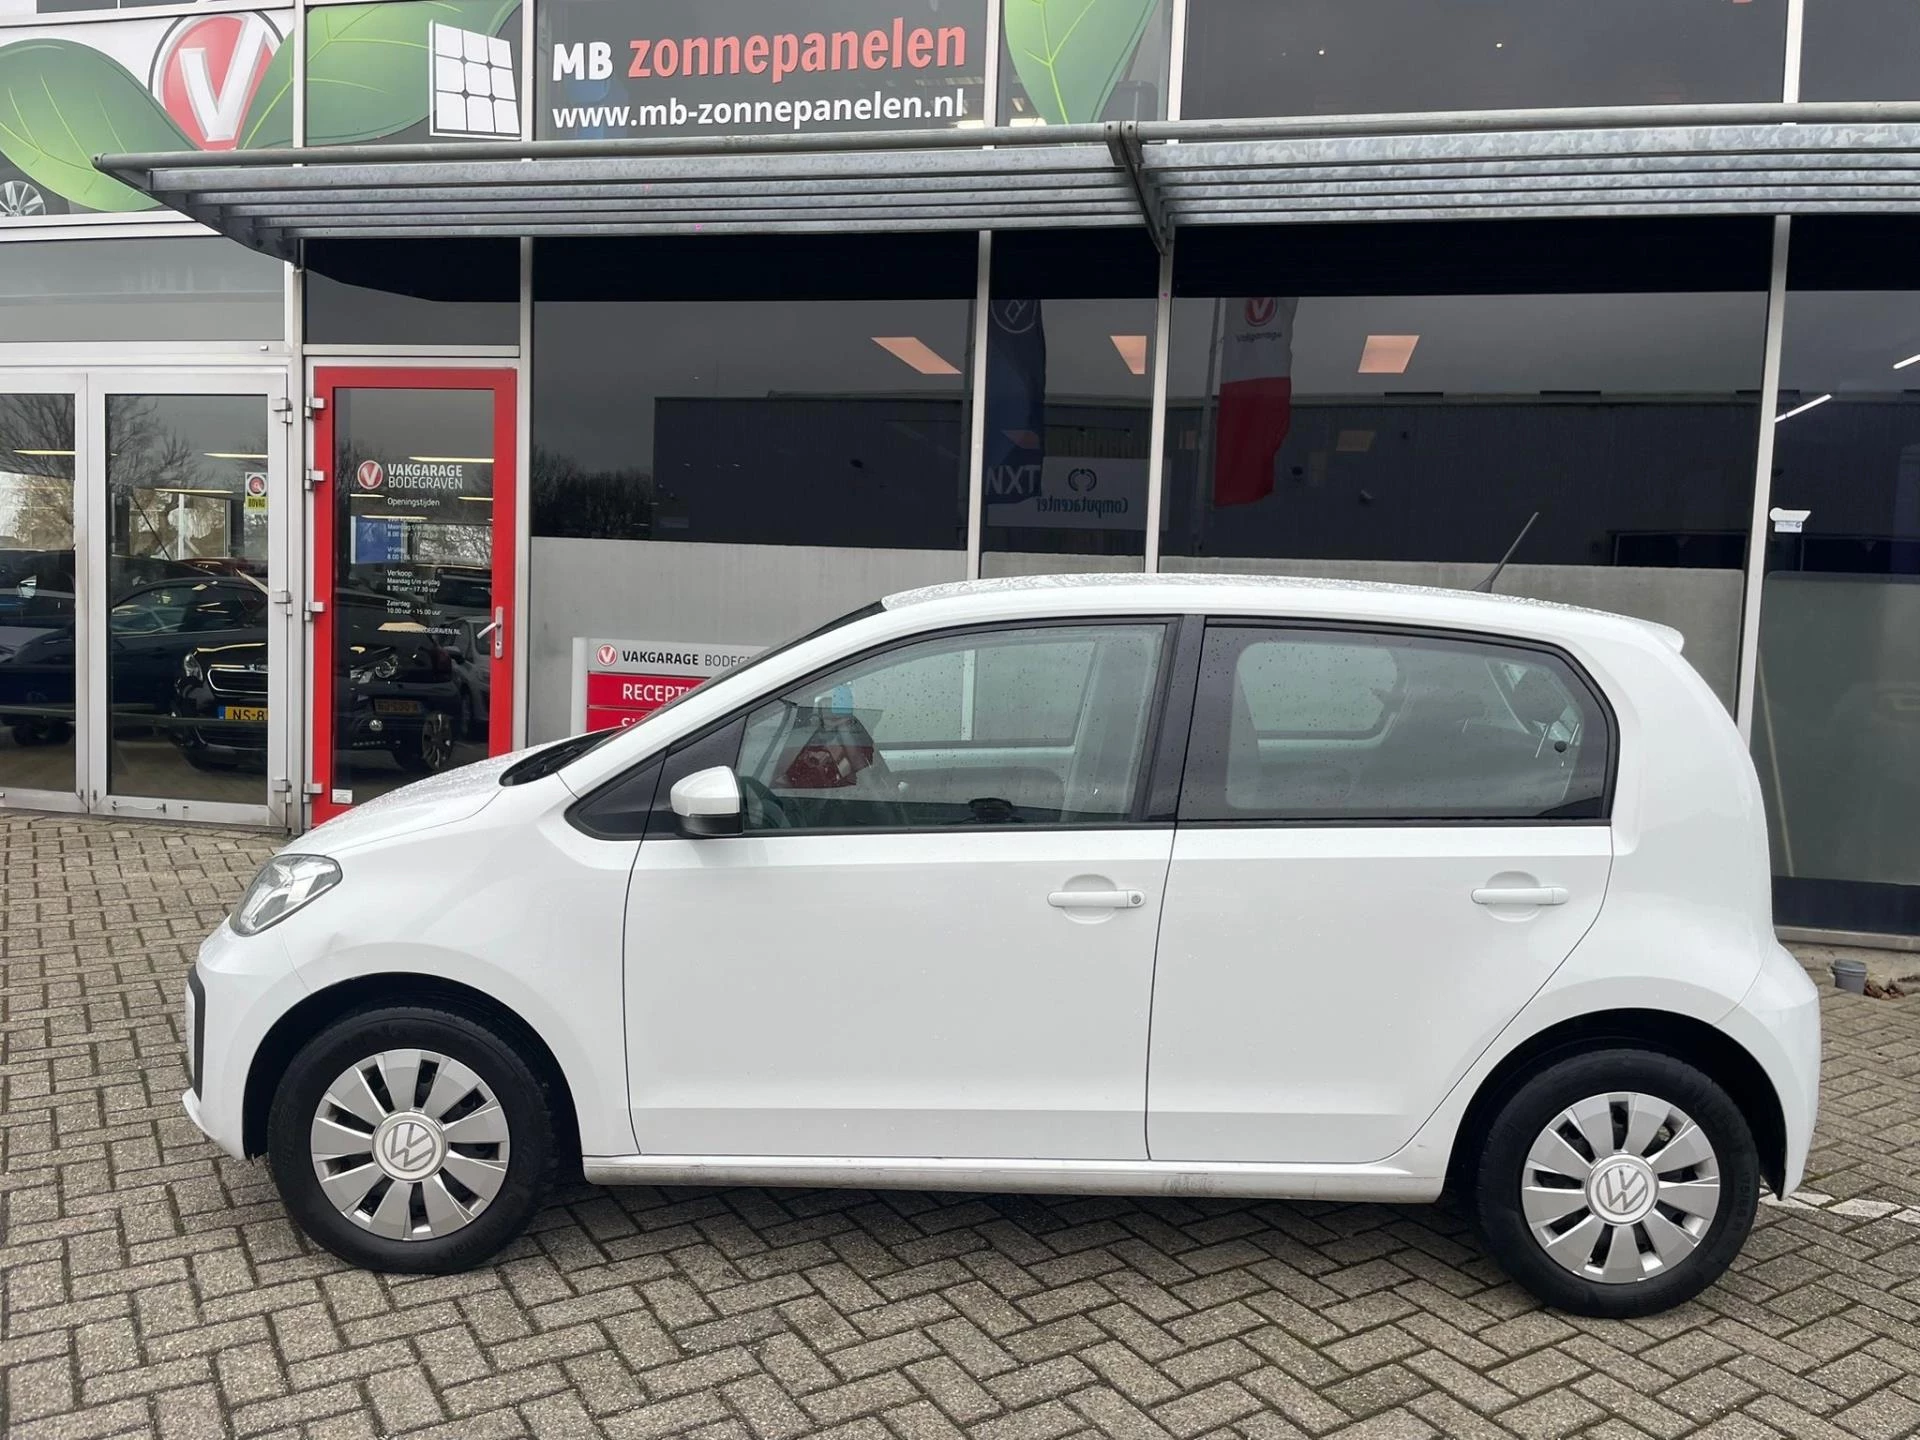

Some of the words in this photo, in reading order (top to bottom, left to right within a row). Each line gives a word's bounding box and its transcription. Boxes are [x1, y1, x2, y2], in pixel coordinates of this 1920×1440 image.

[552, 41, 613, 81] MB
[627, 18, 966, 83] zonnepanelen
[551, 88, 965, 129] www.mb-zonnepanelen.nl
[387, 463, 463, 477] VAKGARAGE
[387, 476, 463, 490] BODEGRAVEN
[387, 497, 440, 507] Openingstijden
[622, 650, 699, 666] VAKGARAGE
[622, 683, 690, 702] RECEPT
